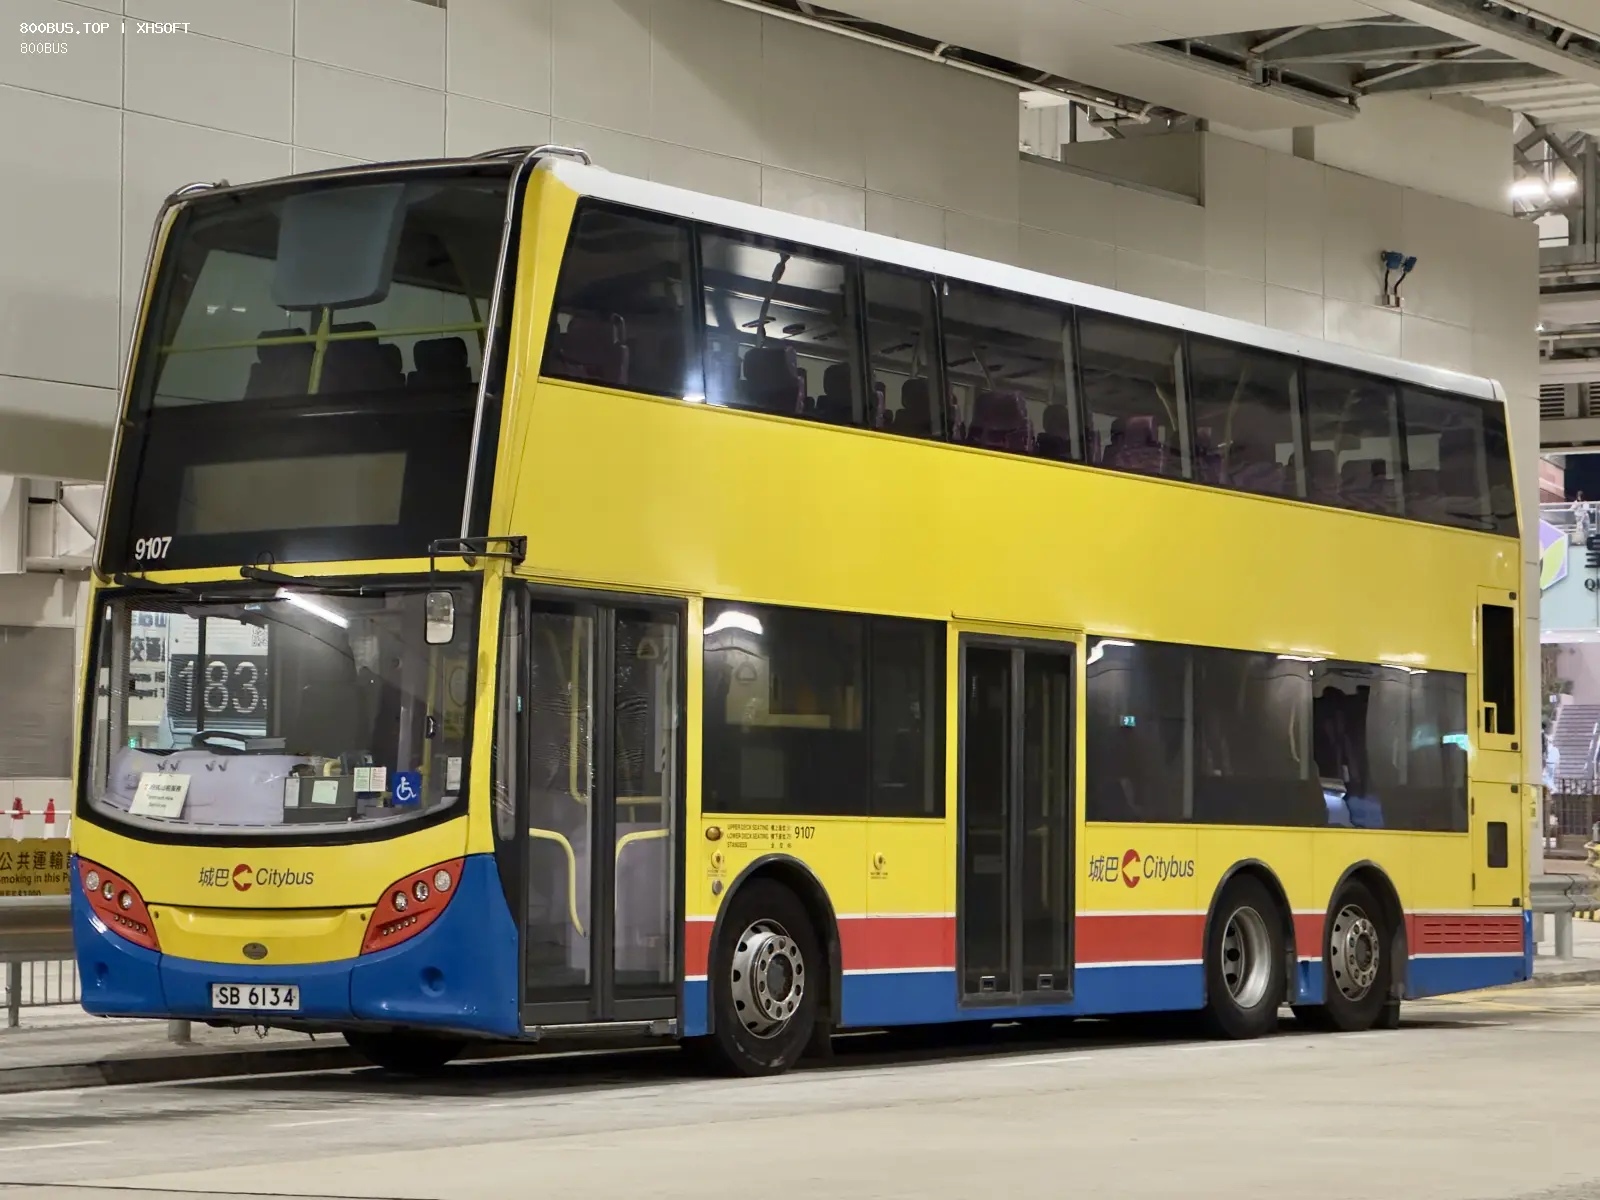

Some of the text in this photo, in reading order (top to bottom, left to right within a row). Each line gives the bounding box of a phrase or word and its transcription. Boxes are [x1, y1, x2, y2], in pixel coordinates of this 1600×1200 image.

[134, 536, 172, 560] 9107
[178, 660, 268, 713] 183
[794, 826, 815, 839] 9107
[198, 867, 229, 887] 城巴
[256, 868, 314, 888] Citybus
[1088, 855, 1119, 882] 城巴
[1143, 855, 1195, 881] Citybus
[0, 873, 31, 886] moking
[34, 874, 42, 883] in
[44, 872, 61, 883] this
[219, 986, 295, 1007] SB 6134
